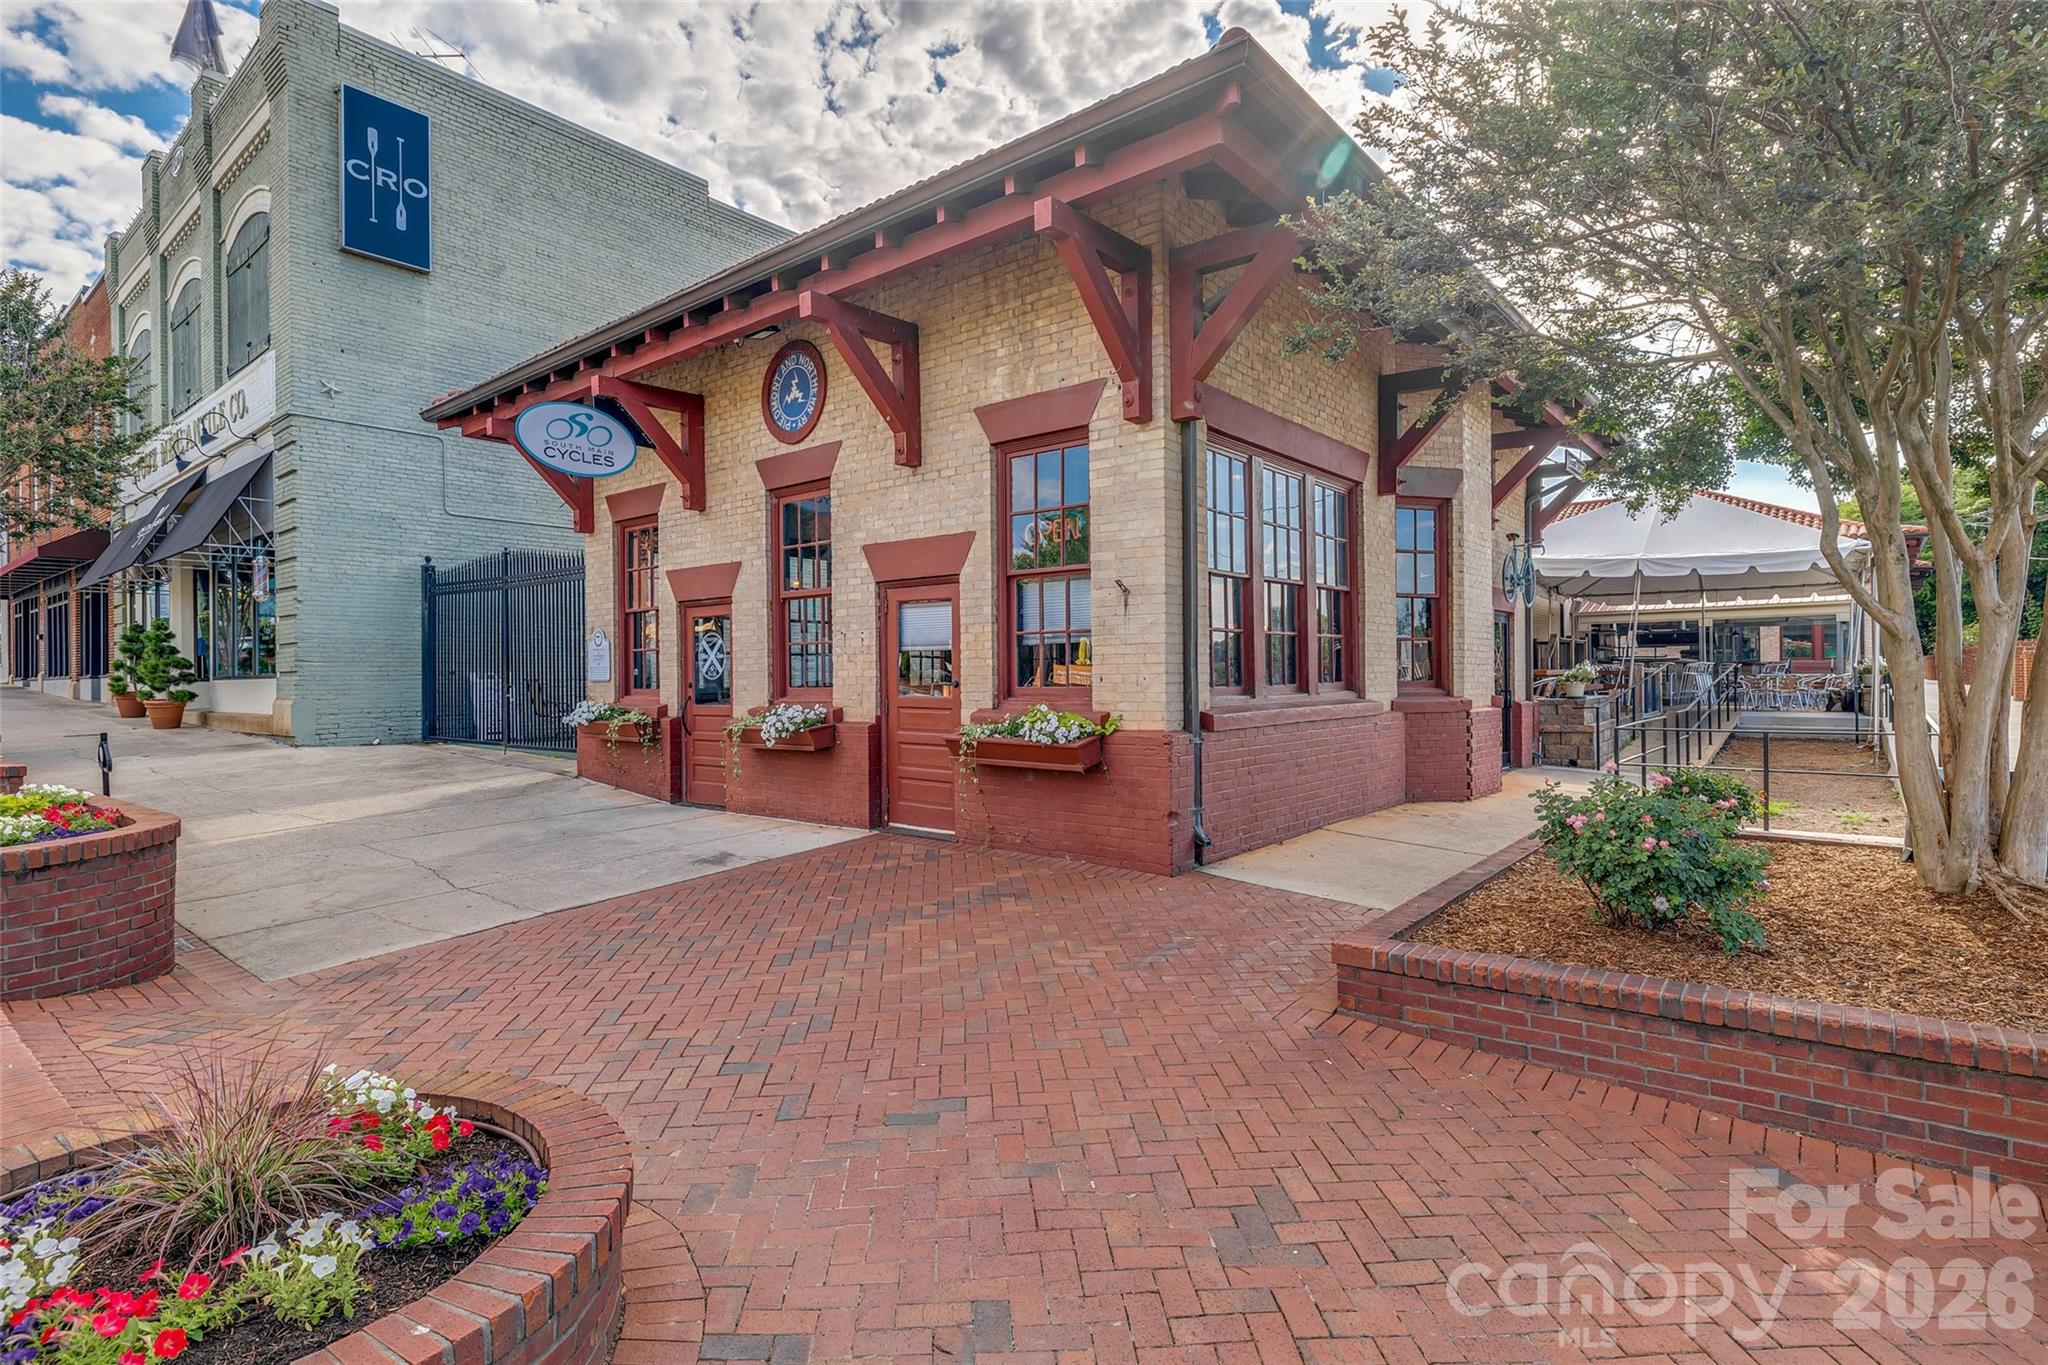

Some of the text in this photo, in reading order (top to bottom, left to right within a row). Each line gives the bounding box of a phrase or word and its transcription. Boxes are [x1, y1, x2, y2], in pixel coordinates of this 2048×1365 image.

[346, 158, 428, 199] CRO
[230, 389, 250, 424] CO.
[771, 373, 791, 430] PIEDMONT
[781, 355, 797, 374] AND
[799, 354, 818, 415] NORTHERN
[544, 440, 614, 456] SOUTH MAIN
[544, 447, 614, 467] CYCLES
[1025, 518, 1081, 546] OPEN
